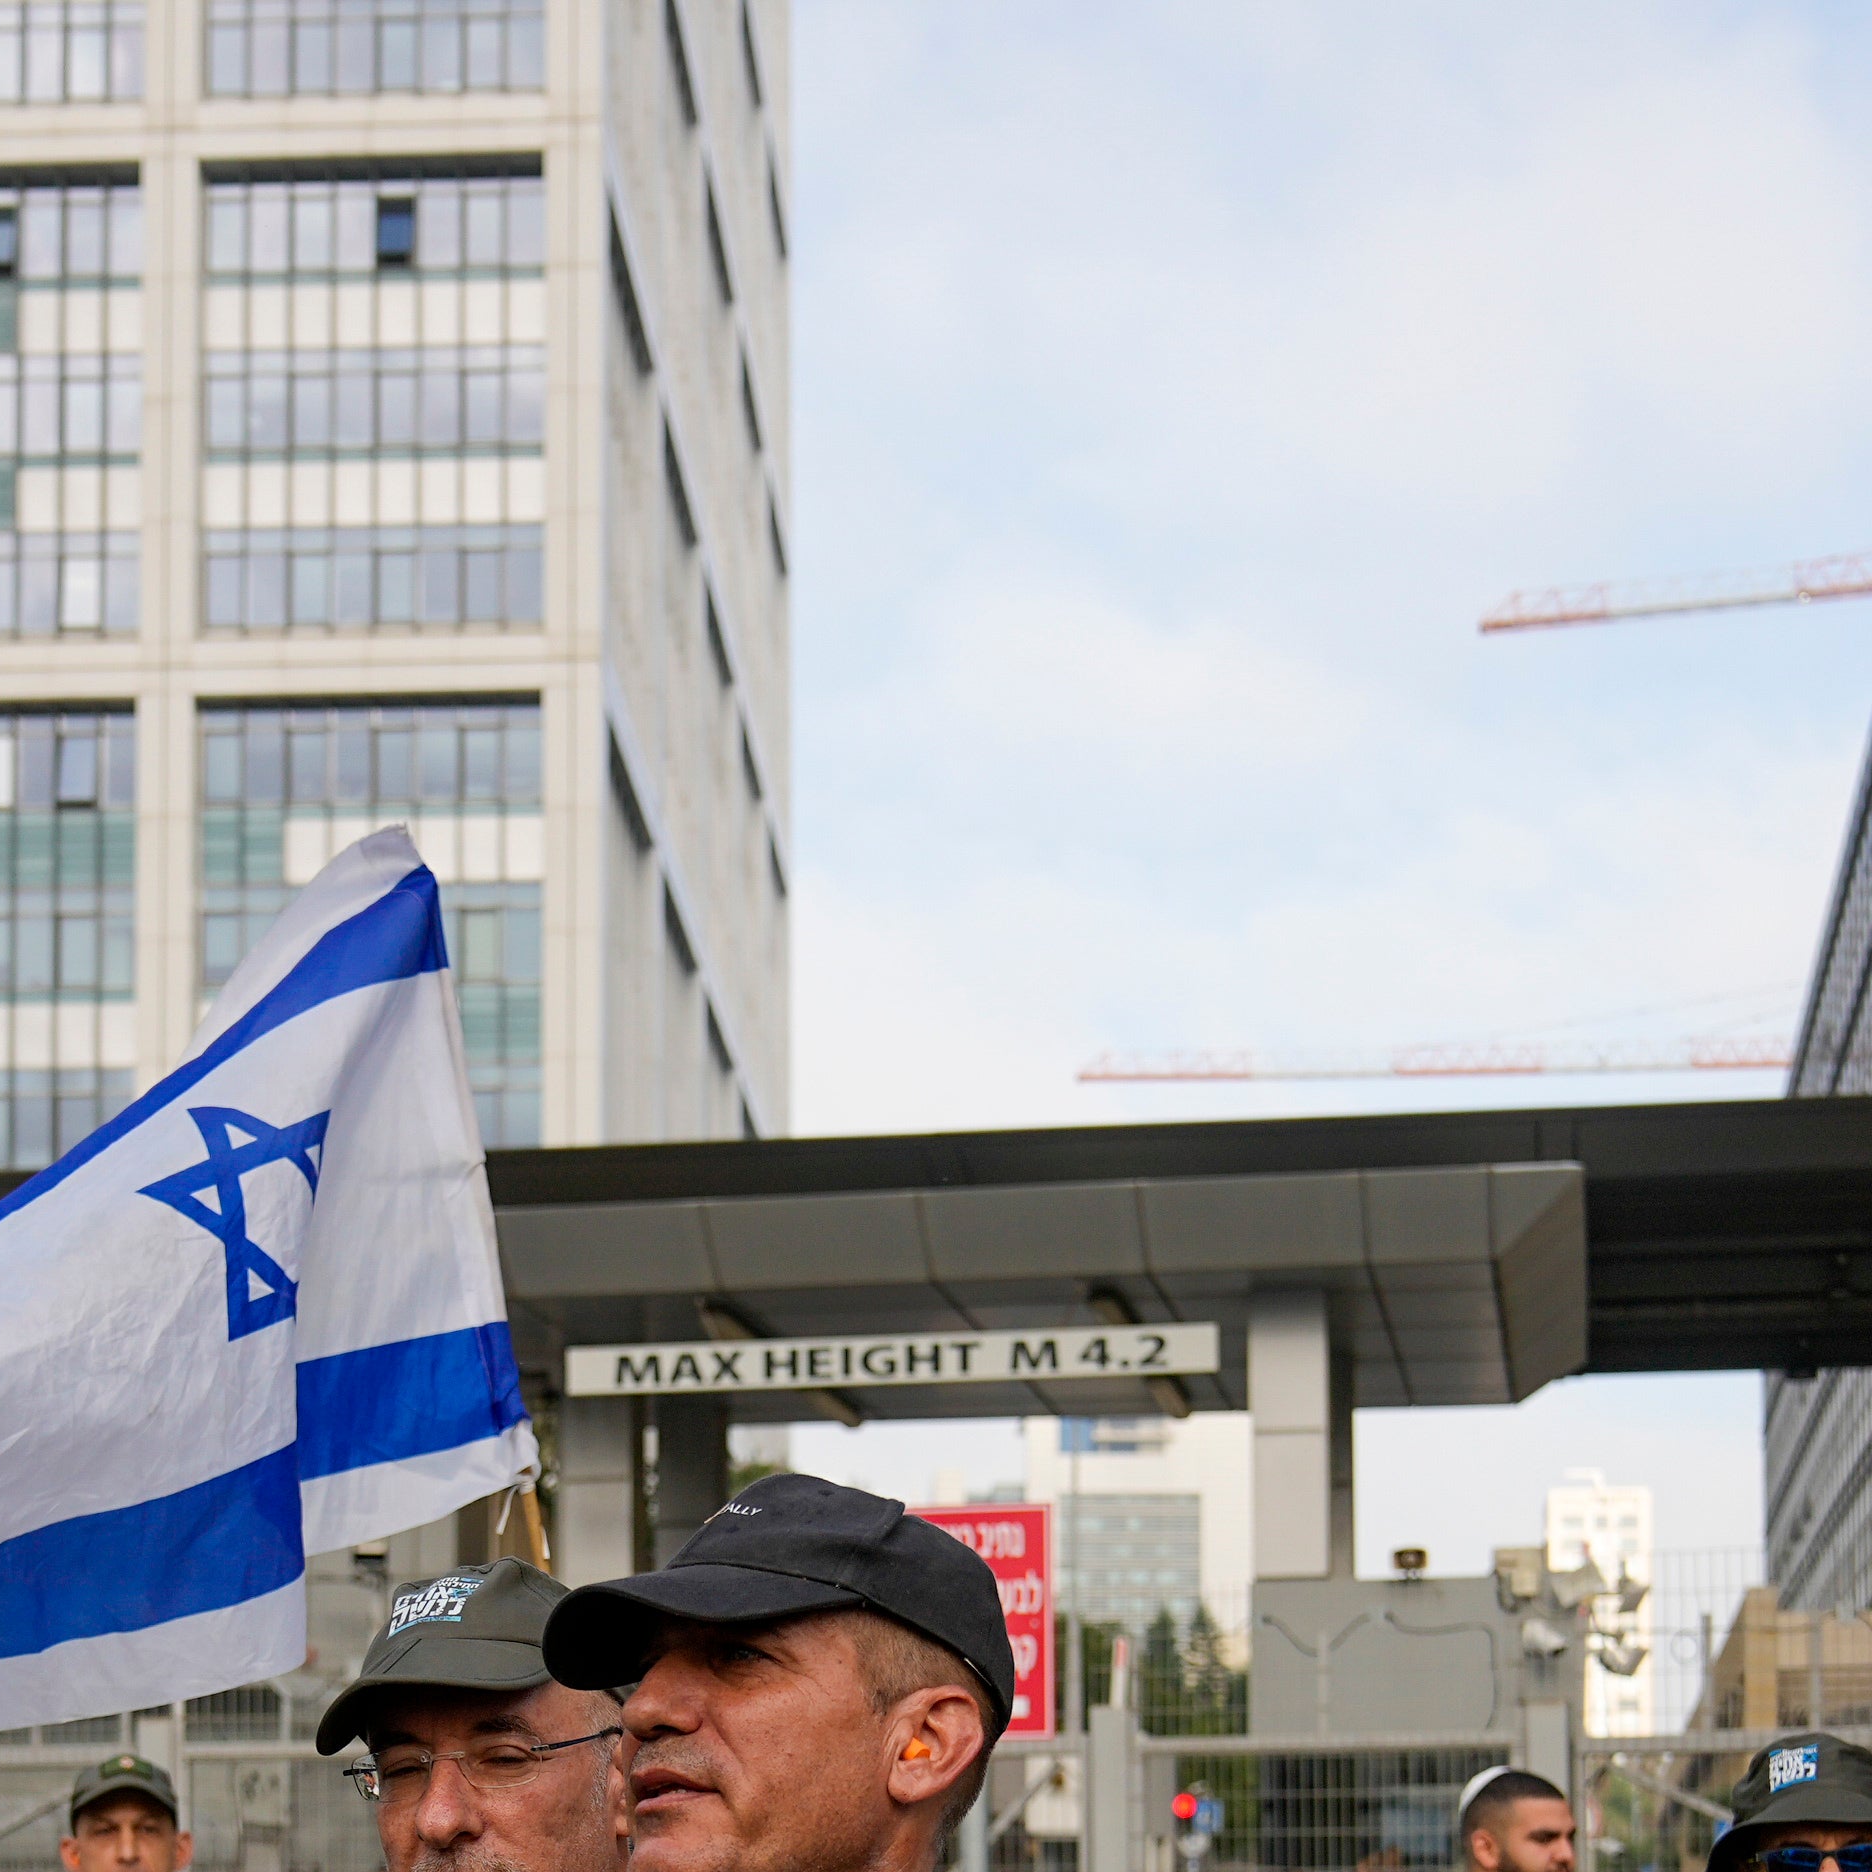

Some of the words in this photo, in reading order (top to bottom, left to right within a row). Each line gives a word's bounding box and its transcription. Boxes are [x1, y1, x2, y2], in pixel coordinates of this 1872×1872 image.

[617, 1352, 740, 1385] MAX
[765, 1343, 977, 1379] HEIGHT
[1011, 1339, 1059, 1370] M
[1081, 1334, 1167, 1367] 4.2
[721, 1503, 763, 1516] ALLY
